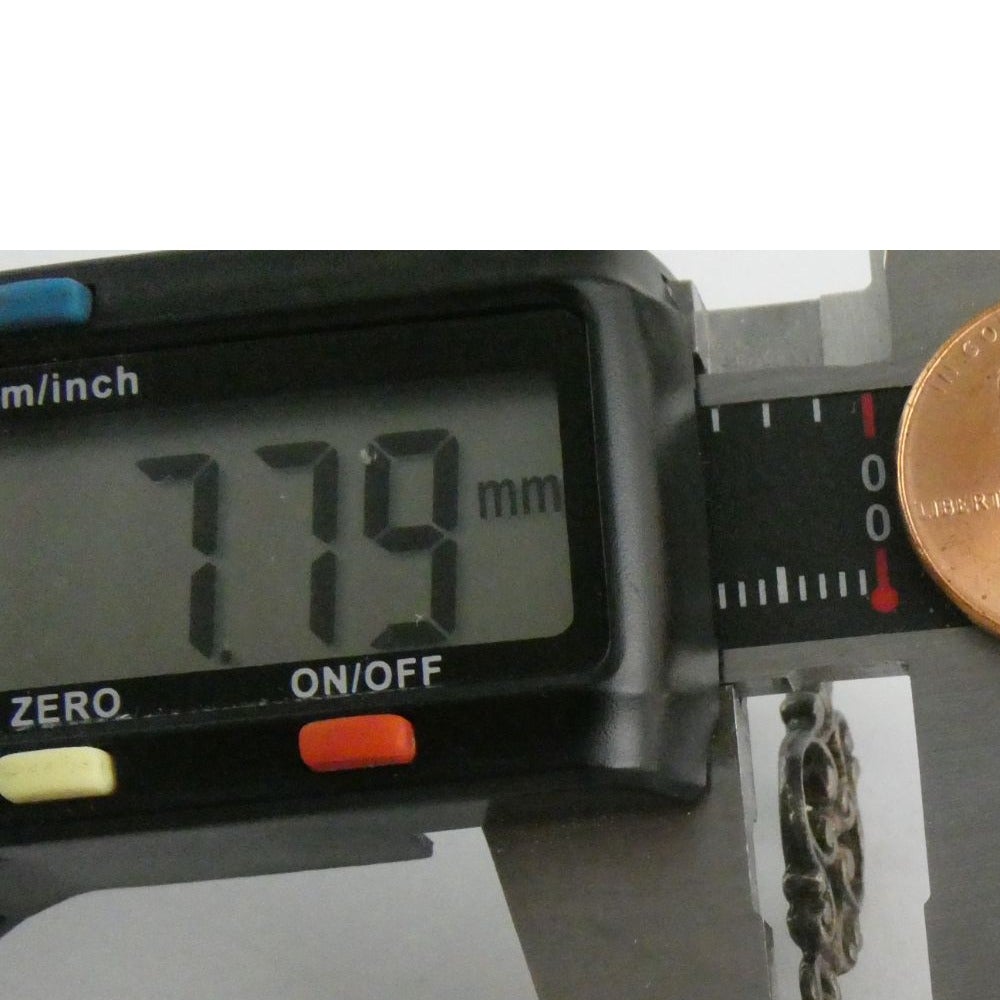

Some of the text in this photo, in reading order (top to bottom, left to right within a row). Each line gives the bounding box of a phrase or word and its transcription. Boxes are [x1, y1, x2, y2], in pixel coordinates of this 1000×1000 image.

[861, 454, 886, 491] 0
[477, 472, 563, 520] mm
[866, 503, 891, 541] 0
[290, 655, 443, 700] ON/OFF
[10, 688, 121, 729] ZERO
